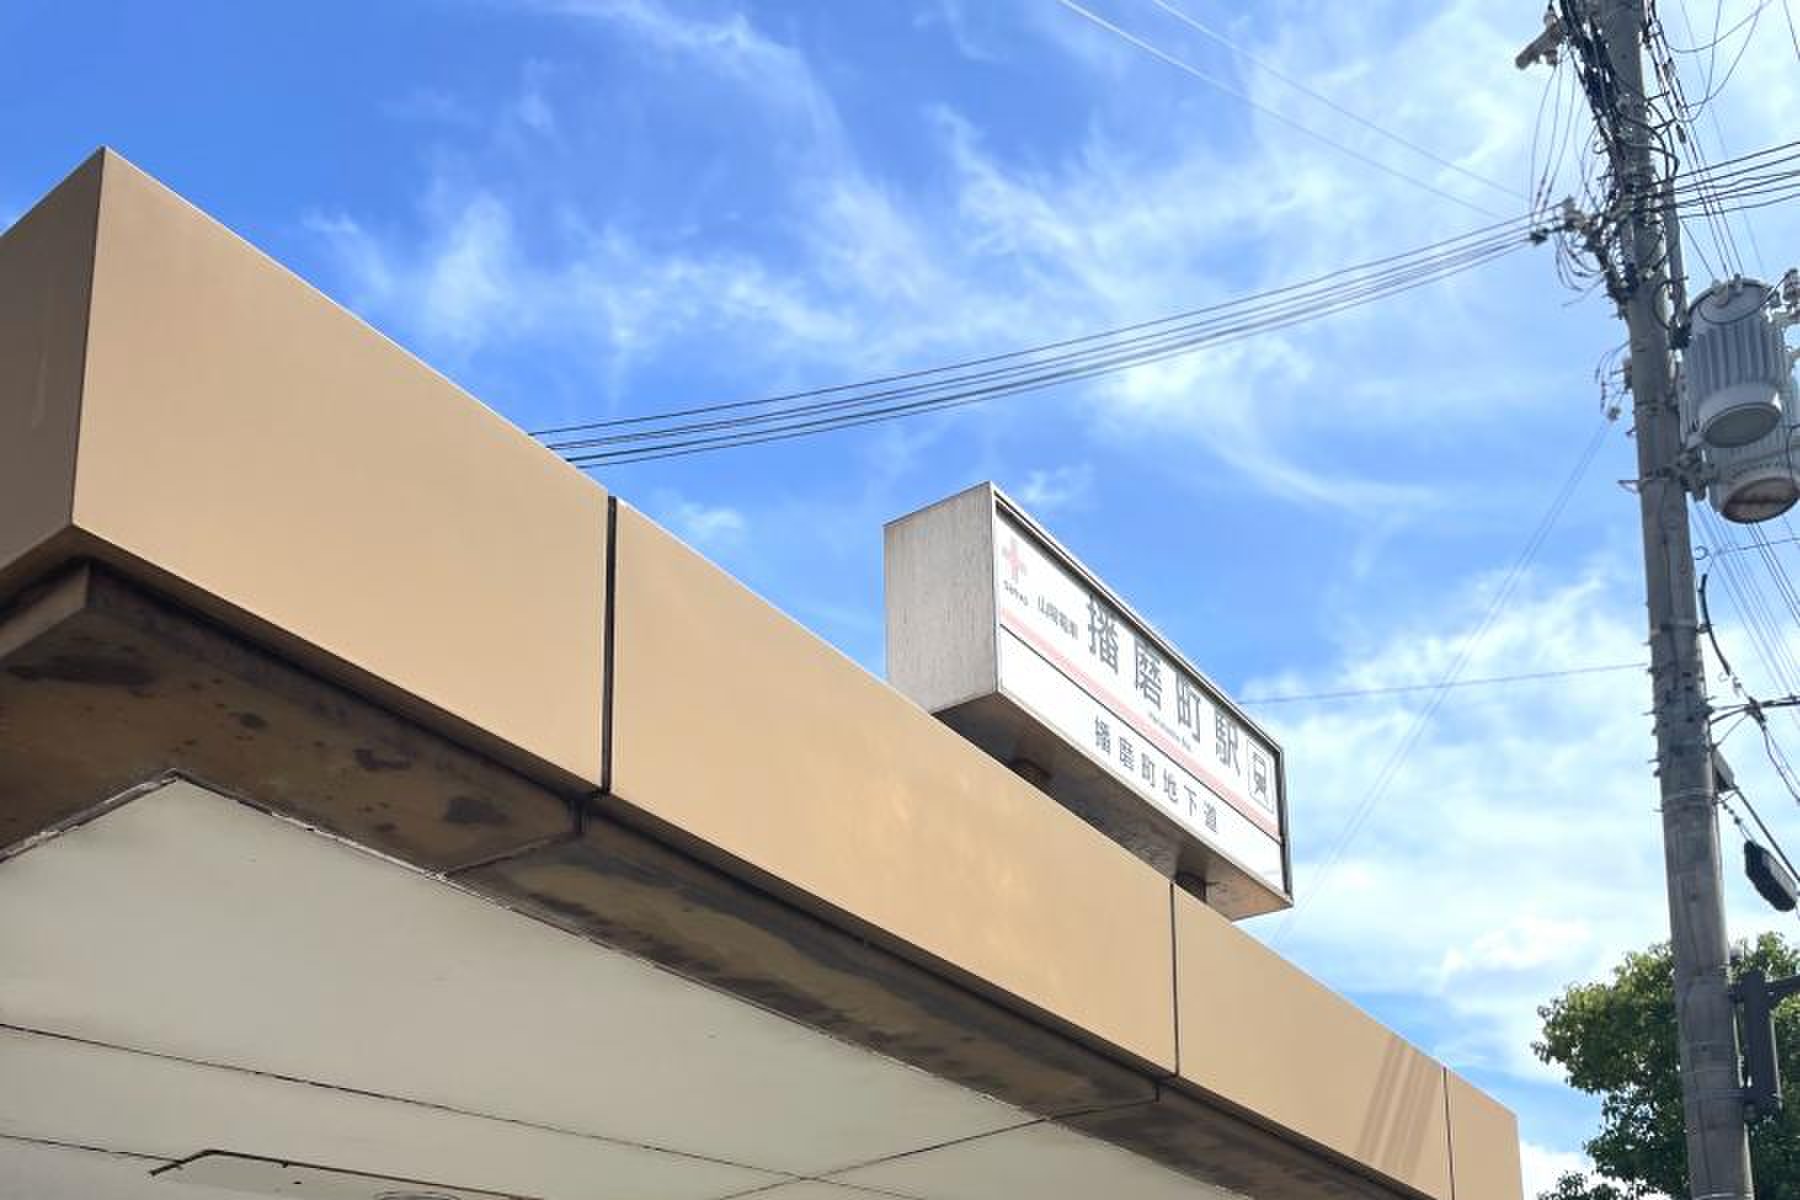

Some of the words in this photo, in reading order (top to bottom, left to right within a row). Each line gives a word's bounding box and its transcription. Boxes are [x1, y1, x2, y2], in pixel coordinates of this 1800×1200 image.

[1085, 593, 1241, 778] 播磨町駅
[1094, 715, 1217, 834] 播磨町地下道
